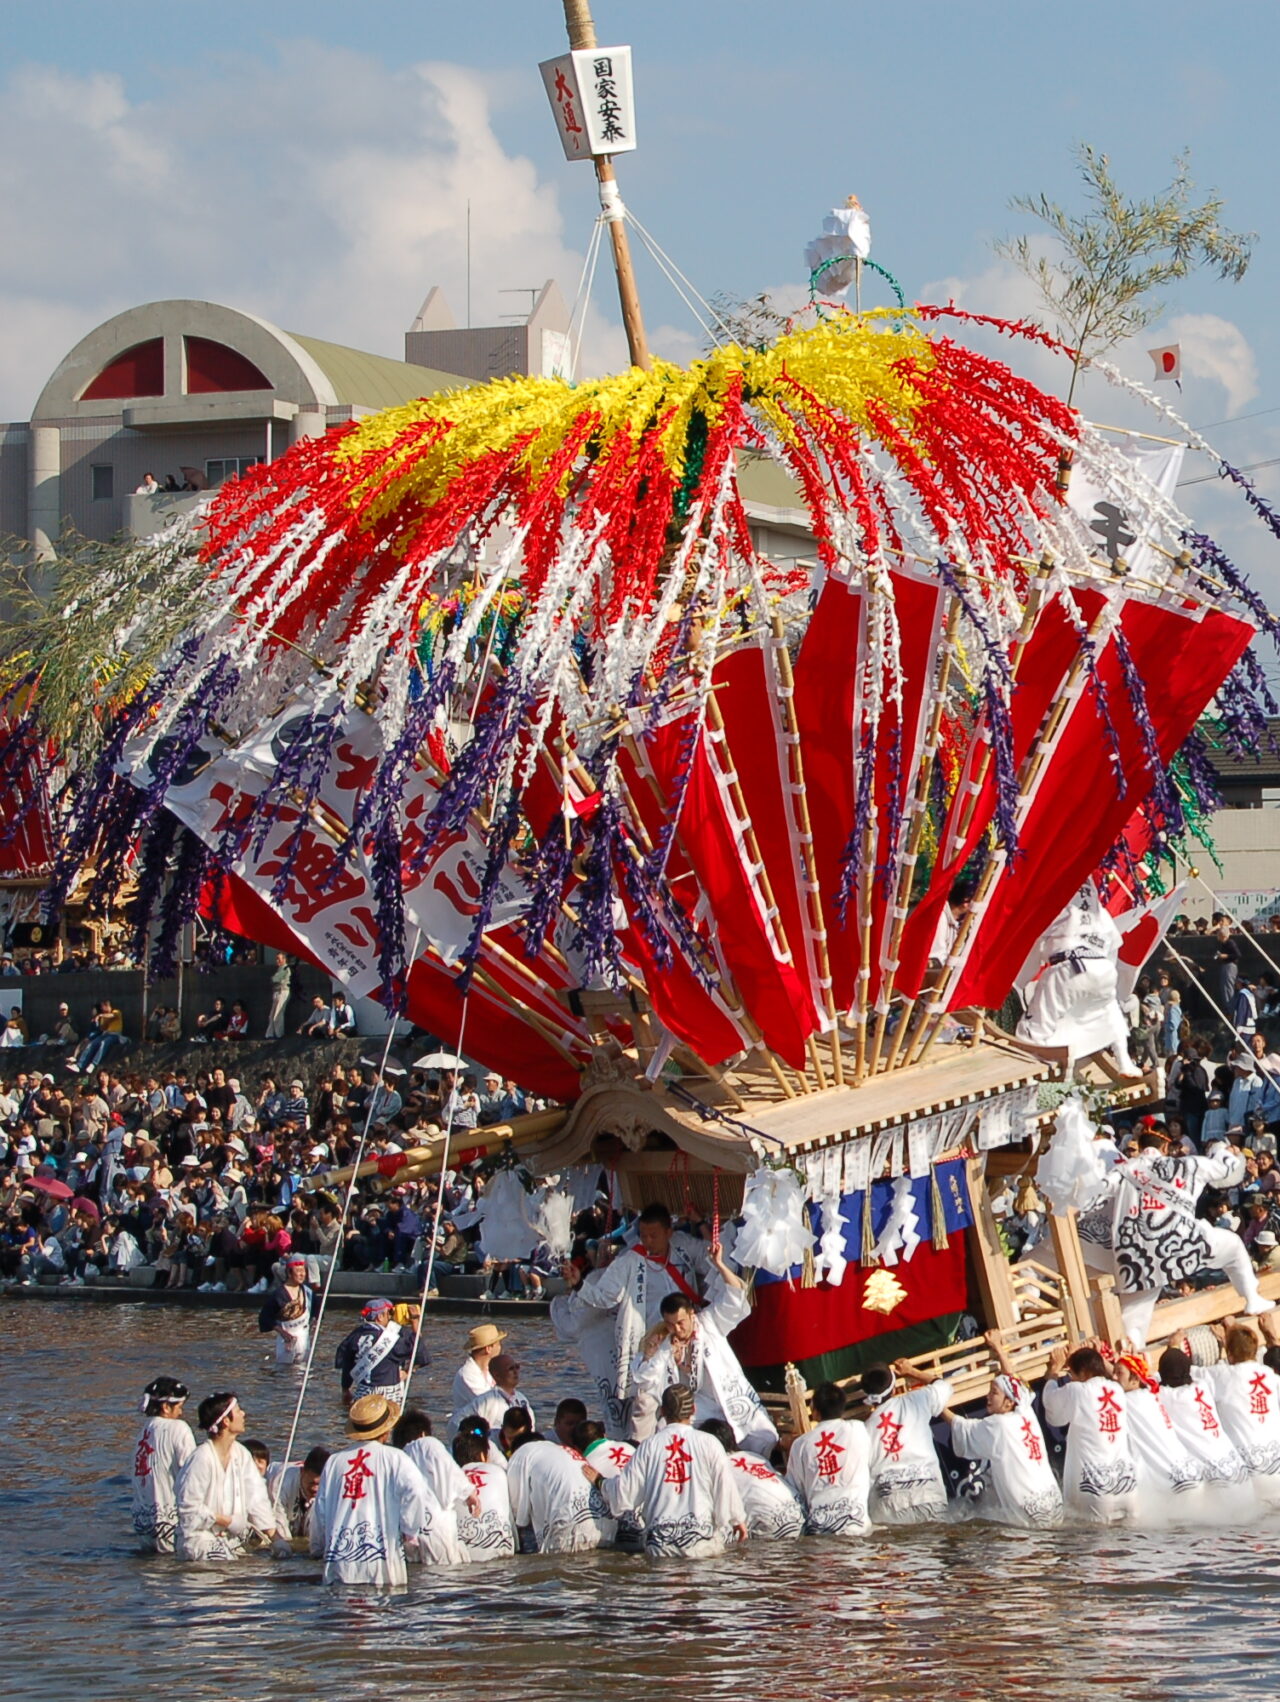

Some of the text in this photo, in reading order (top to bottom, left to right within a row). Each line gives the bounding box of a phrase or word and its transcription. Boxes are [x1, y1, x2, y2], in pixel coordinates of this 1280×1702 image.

[555, 67, 582, 150] 大通り
[594, 57, 626, 143] 国家安泰
[1098, 1386, 1122, 1444] 大通り
[1194, 1386, 1220, 1438] 大通り
[1248, 1371, 1272, 1424] 大通り
[343, 1449, 374, 1510] 大通り
[664, 1434, 692, 1494] 大通り
[814, 1431, 845, 1485] 大通り
